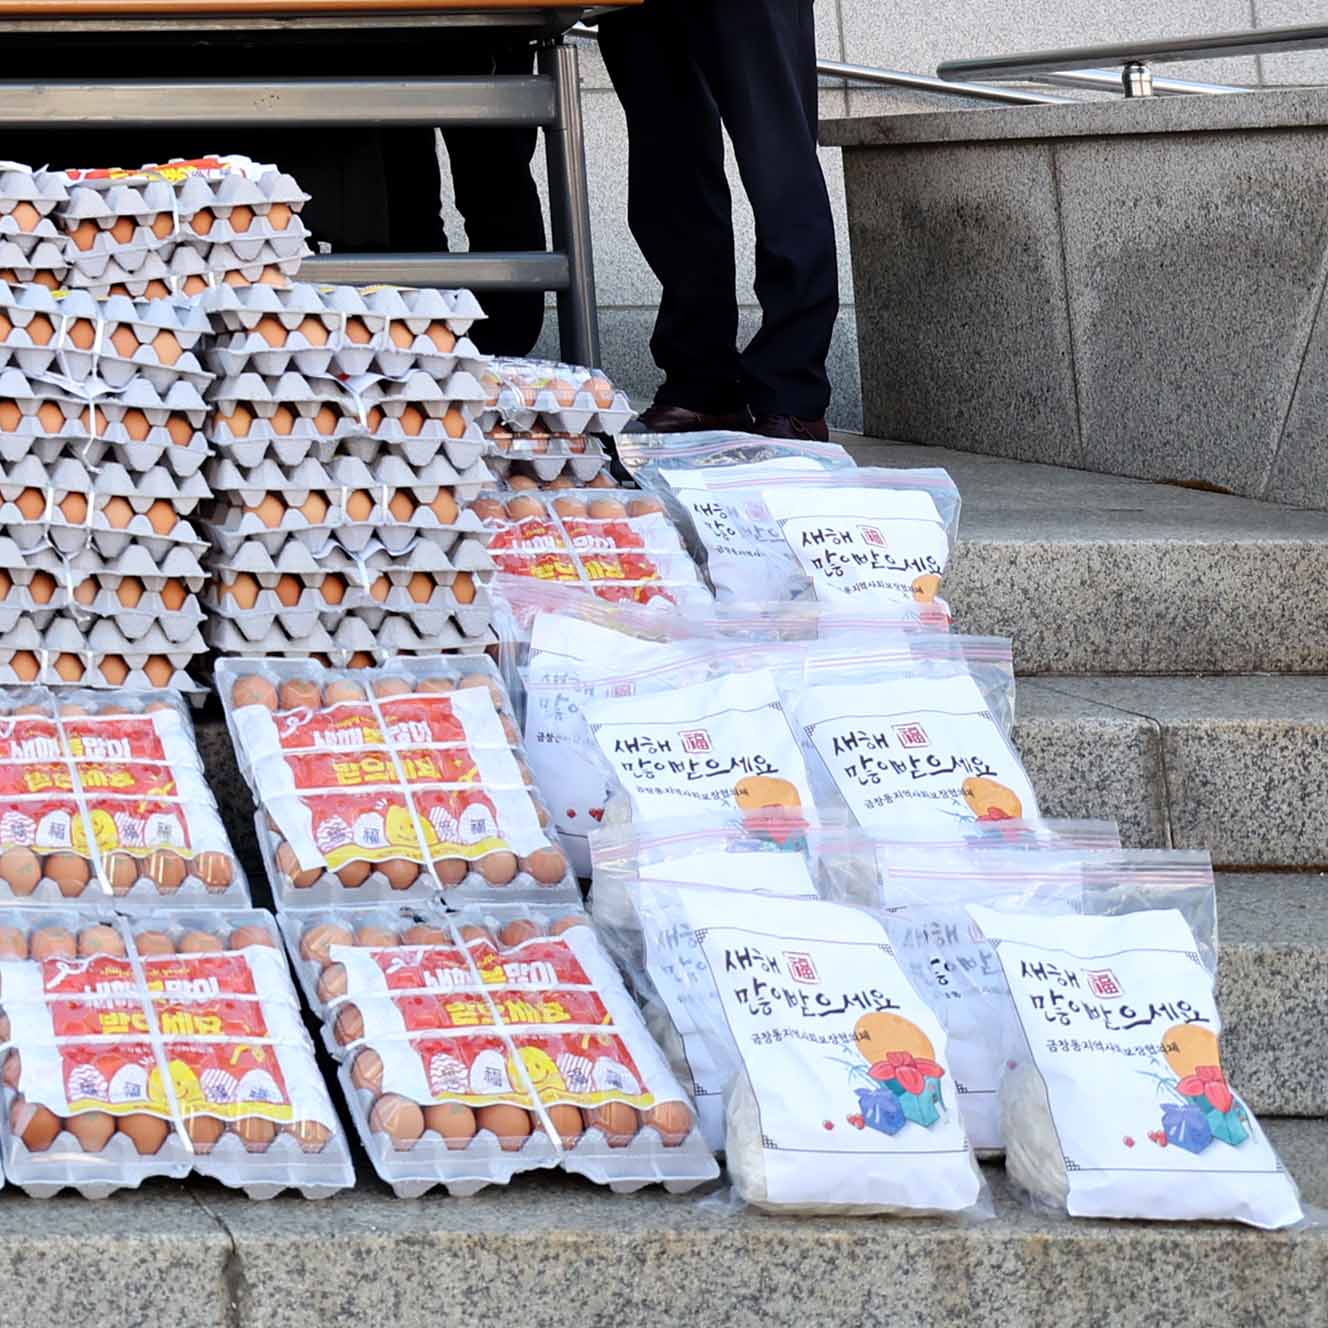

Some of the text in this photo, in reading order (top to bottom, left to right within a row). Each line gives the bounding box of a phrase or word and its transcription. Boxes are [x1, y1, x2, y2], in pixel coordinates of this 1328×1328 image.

[615, 736, 672, 754] 새해
[833, 731, 890, 756] 새해
[725, 946, 781, 974] 새해
[1020, 960, 1081, 990] 새해
